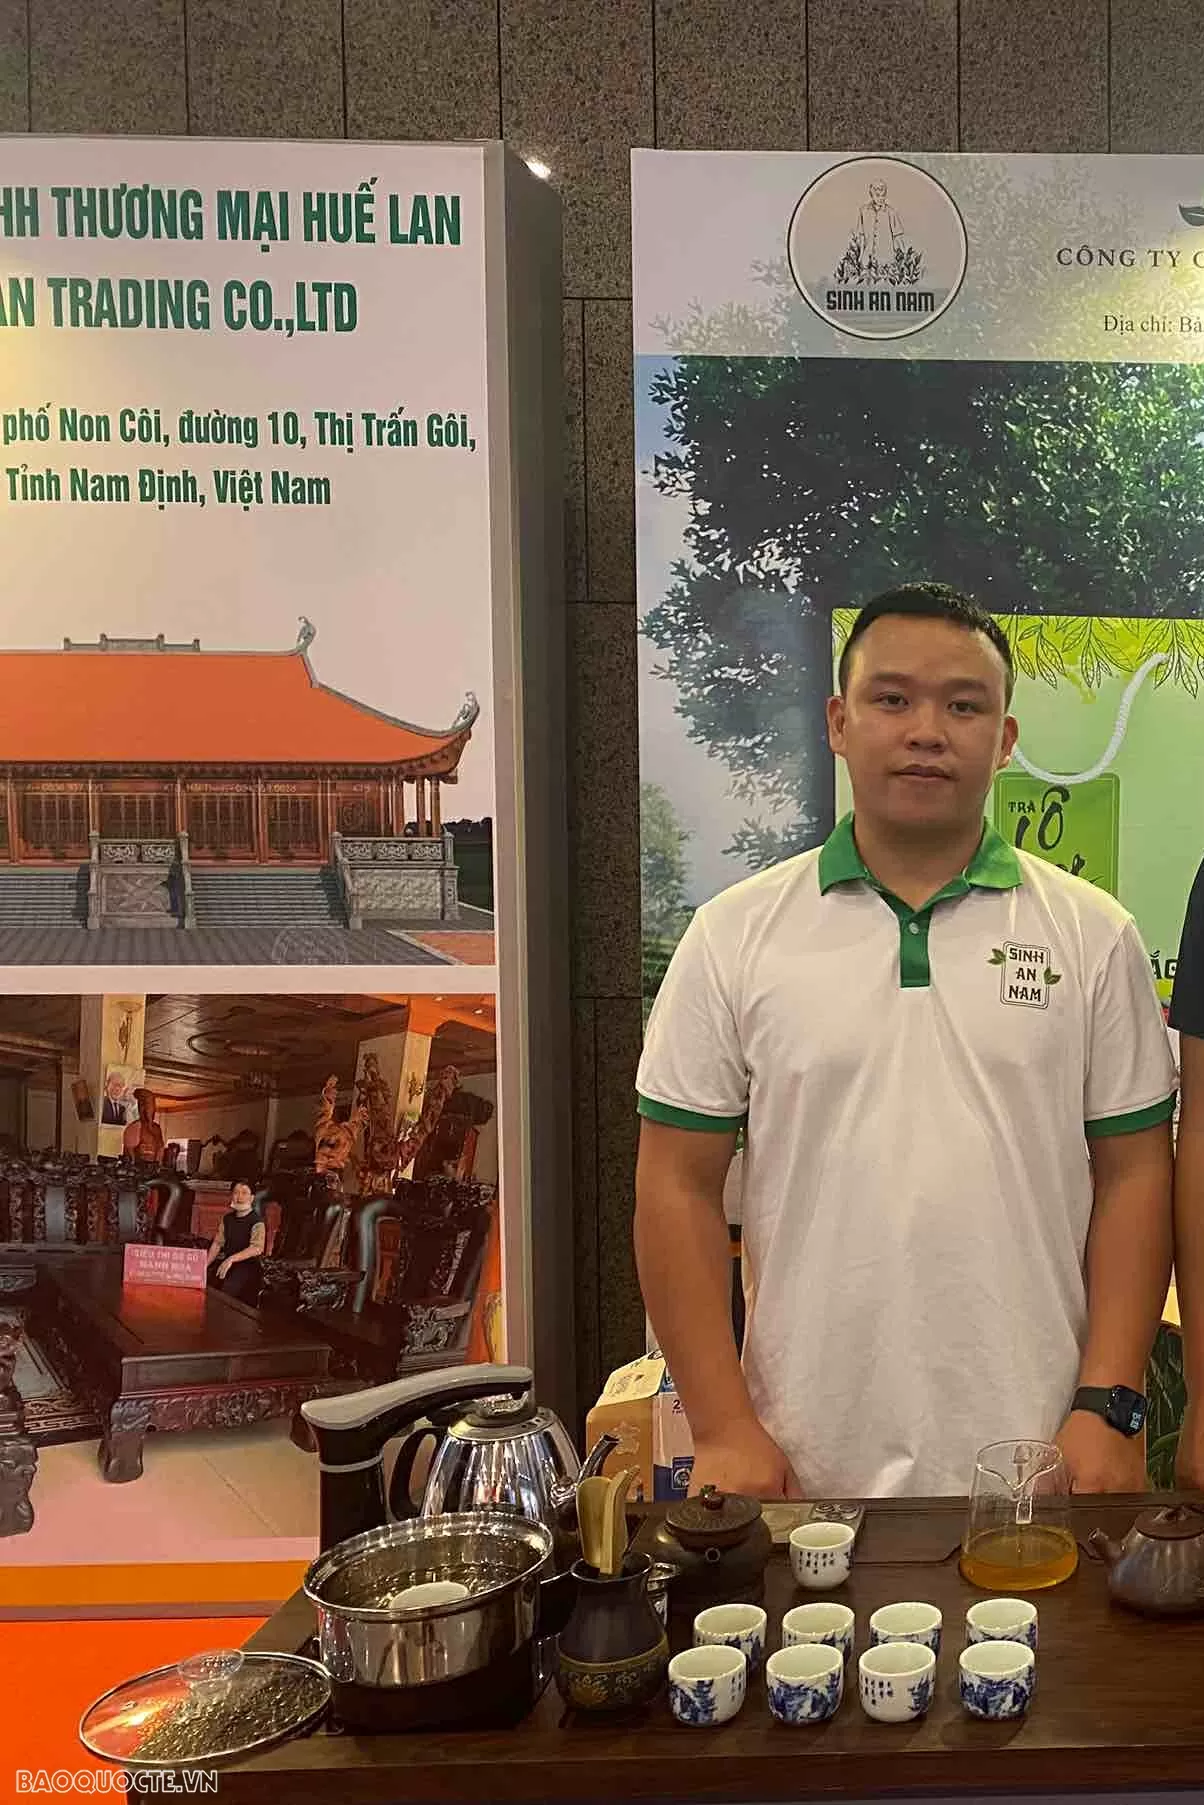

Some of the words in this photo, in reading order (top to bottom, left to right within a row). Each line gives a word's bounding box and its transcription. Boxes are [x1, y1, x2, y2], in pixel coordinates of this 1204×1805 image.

[51, 183, 203, 239] THƯƠNG
[217, 191, 290, 252] MẠI
[304, 177, 376, 243] HUẾ
[389, 193, 461, 245] LAN
[1056, 244, 1136, 268] CÔNG
[1147, 249, 1182, 268] TY
[47, 278, 211, 330] TRADING
[223, 280, 359, 337] CO.,LTD
[826, 290, 865, 311] SINH
[869, 291, 891, 311] AN
[895, 291, 935, 312] NAM
[1103, 315, 1135, 335] Địa
[3, 402, 50, 445] phố
[60, 407, 111, 442] Non
[119, 406, 170, 447] Côi,
[179, 409, 258, 448] đường
[268, 411, 306, 450] 10,
[314, 410, 354, 454] Thị
[361, 406, 418, 447] Trấn
[427, 411, 477, 452] Gôi,
[6, 463, 61, 502] Tỉnh
[70, 468, 130, 502] Nam
[139, 468, 206, 510] Định,
[213, 470, 263, 511] Việt
[272, 471, 331, 504] Nam
[1009, 947, 1044, 964] SINH
[1016, 967, 1037, 981] AN
[1008, 985, 1041, 1002] NAM
